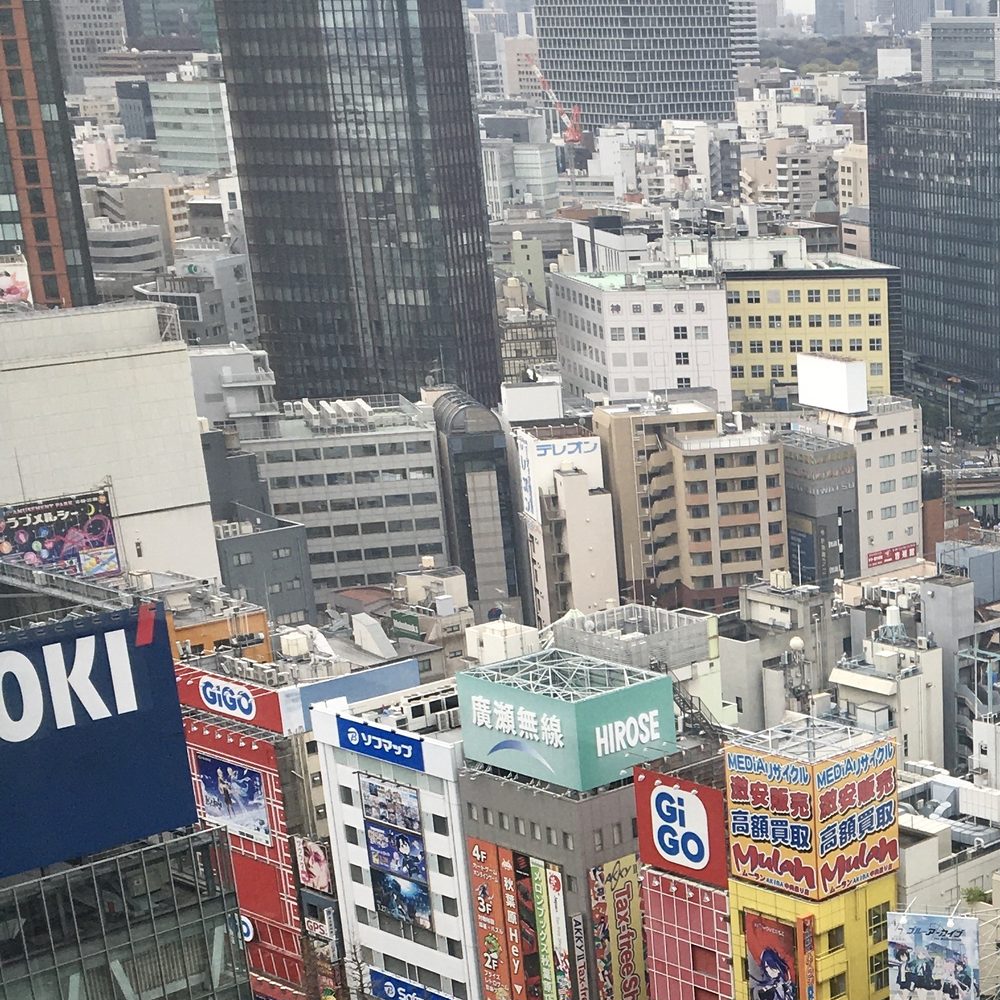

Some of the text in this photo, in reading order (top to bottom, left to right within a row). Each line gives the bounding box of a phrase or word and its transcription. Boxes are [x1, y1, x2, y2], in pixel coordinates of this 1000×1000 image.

[610, 302, 706, 314] 神田郵便局
[536, 440, 598, 457] テレオン
[0, 628, 139, 743] OKI
[202, 680, 254, 716] GiGO
[471, 695, 564, 749] 廣瀬無線
[595, 709, 661, 758] HIROSE
[360, 731, 413, 758] ソフマップ
[730, 775, 812, 819] 激安販売
[819, 767, 896, 822] 激安販売
[731, 809, 812, 850] 高額買取
[820, 800, 895, 857] 高額買取
[471, 843, 488, 862] 4F
[731, 842, 817, 890] Mulan
[820, 836, 899, 894] Mulan
[477, 896, 493, 914] 3F
[503, 875, 522, 974] 秋葉原 Hey
[572, 918, 585, 952] AKKY
[483, 952, 499, 971] 2F
